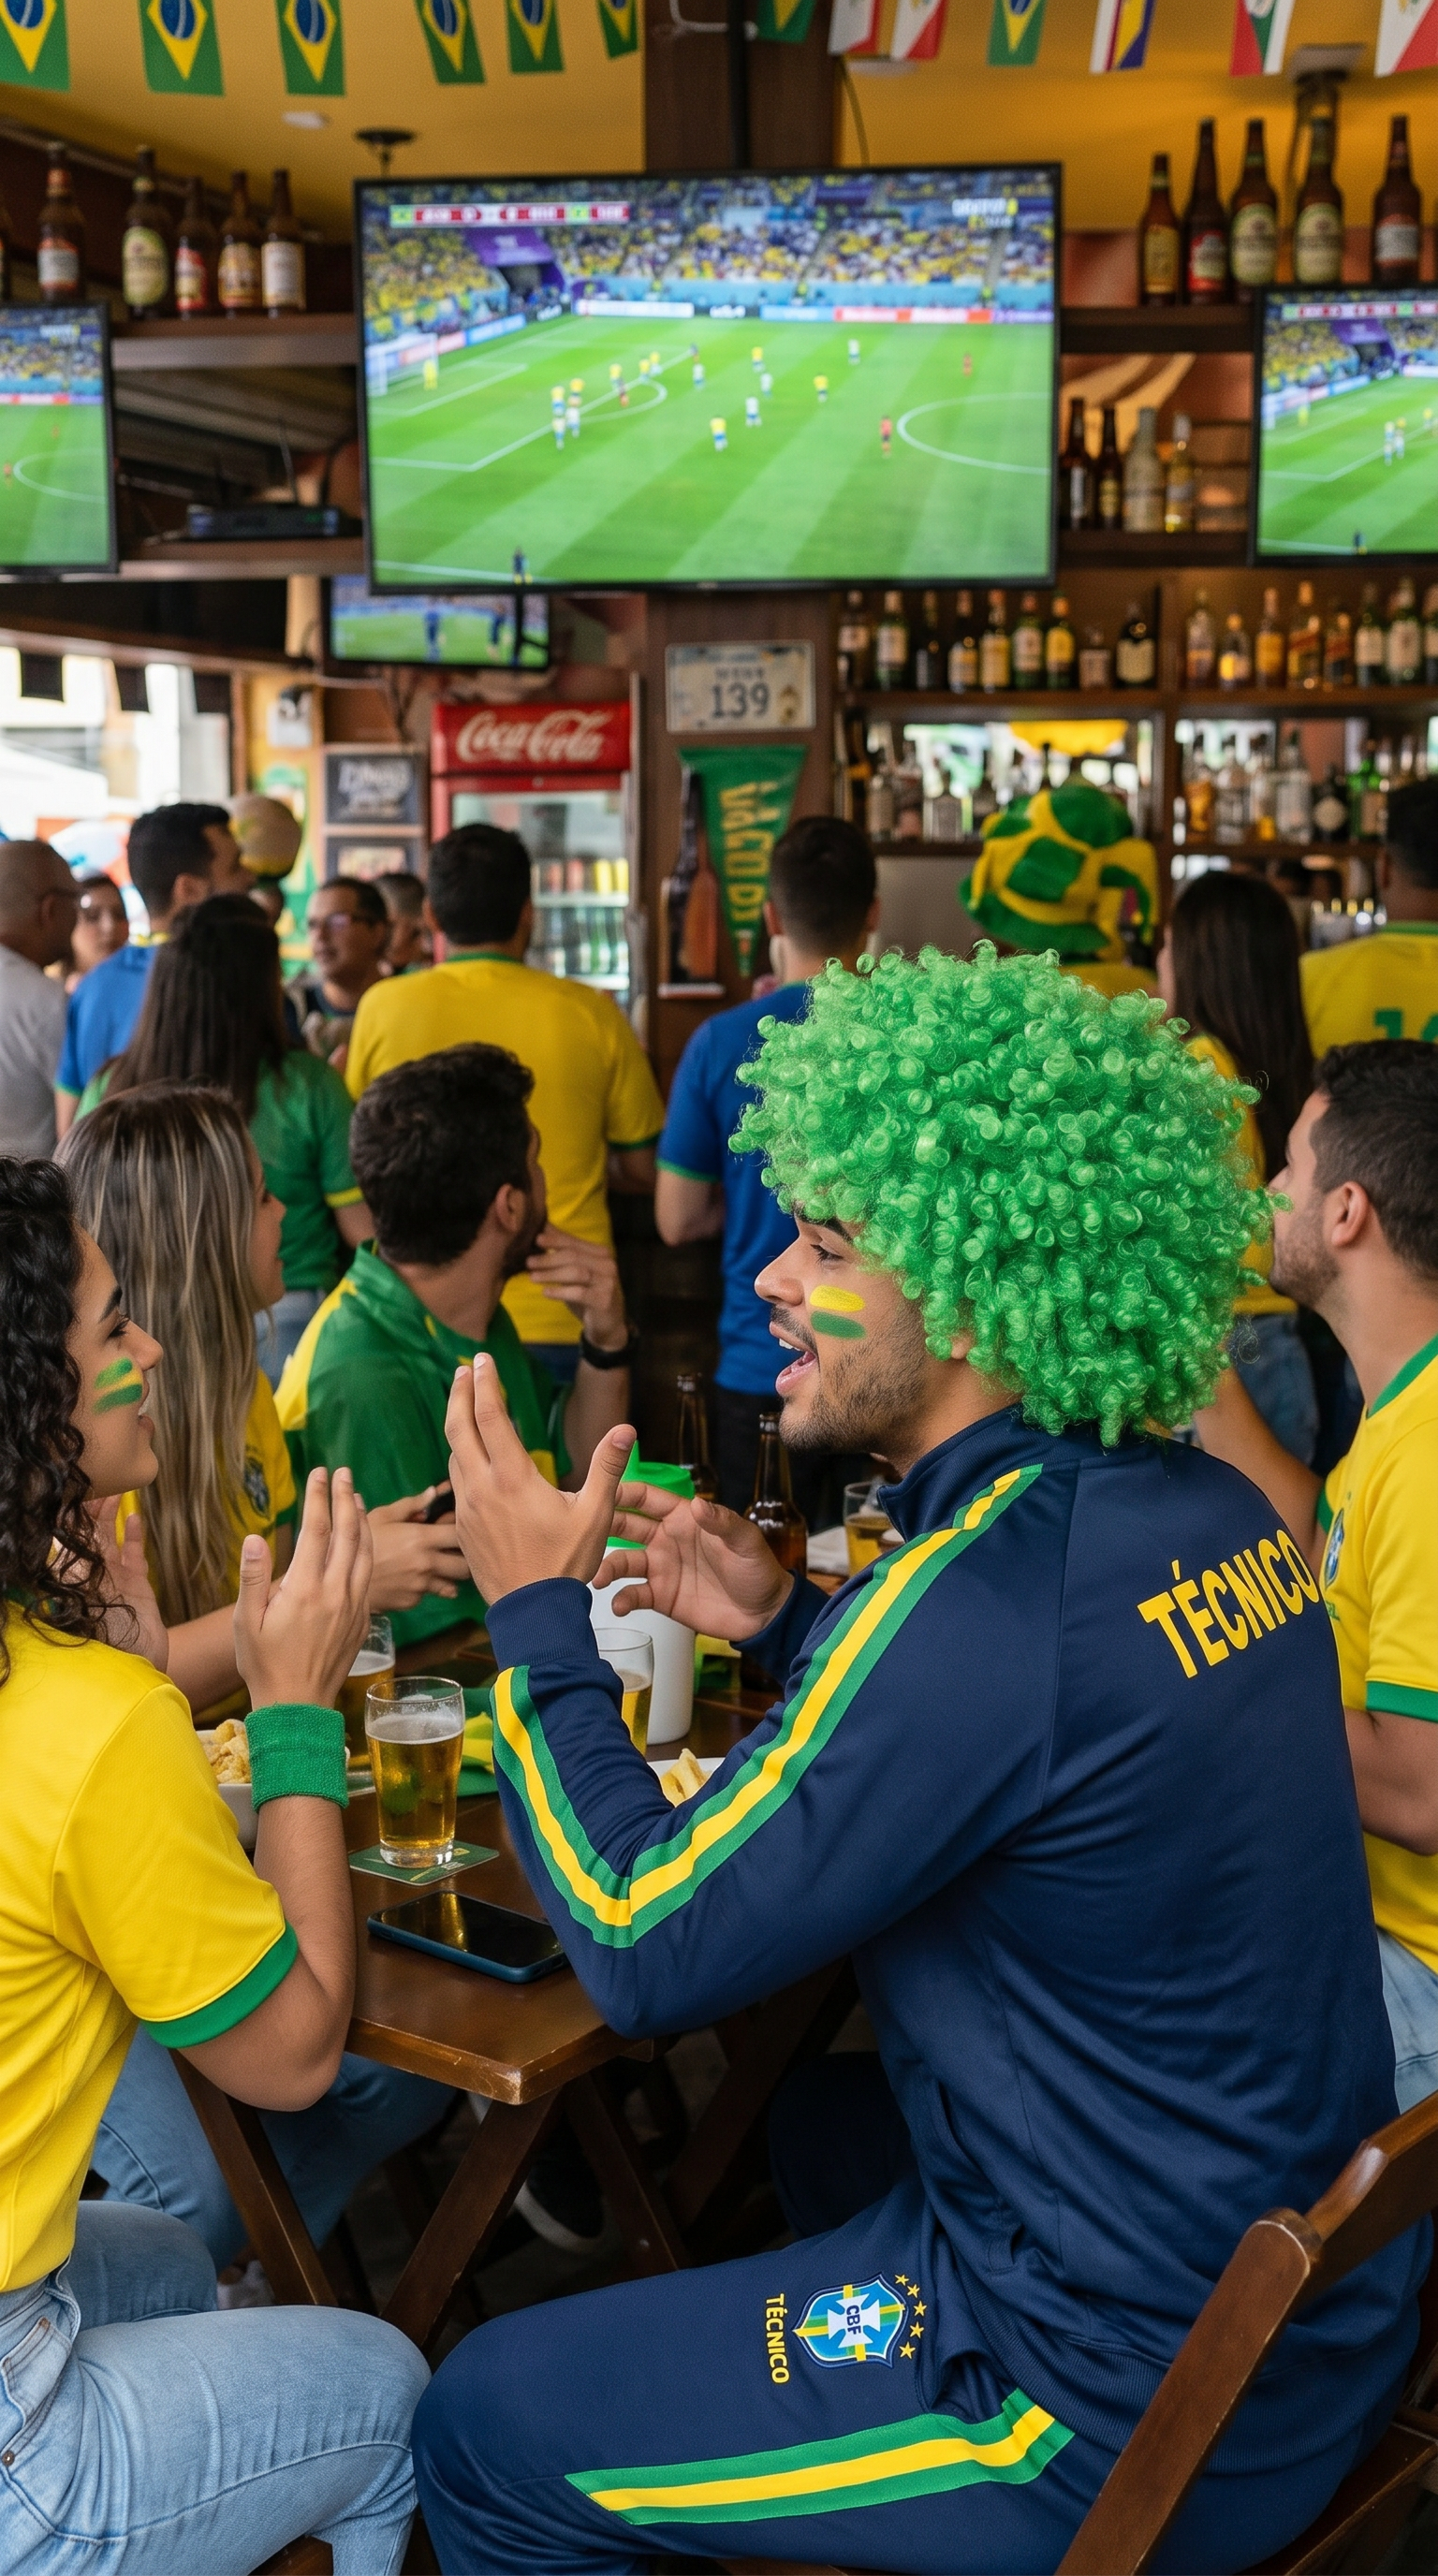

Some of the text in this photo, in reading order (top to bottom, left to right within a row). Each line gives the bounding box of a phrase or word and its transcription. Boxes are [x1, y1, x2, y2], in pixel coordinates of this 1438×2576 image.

[712, 681, 770, 719] 139
[1137, 1529, 1320, 1679] TÉCNICO
[766, 2292, 790, 2384] TÉCNICO
[845, 2305, 862, 2335] CBF
